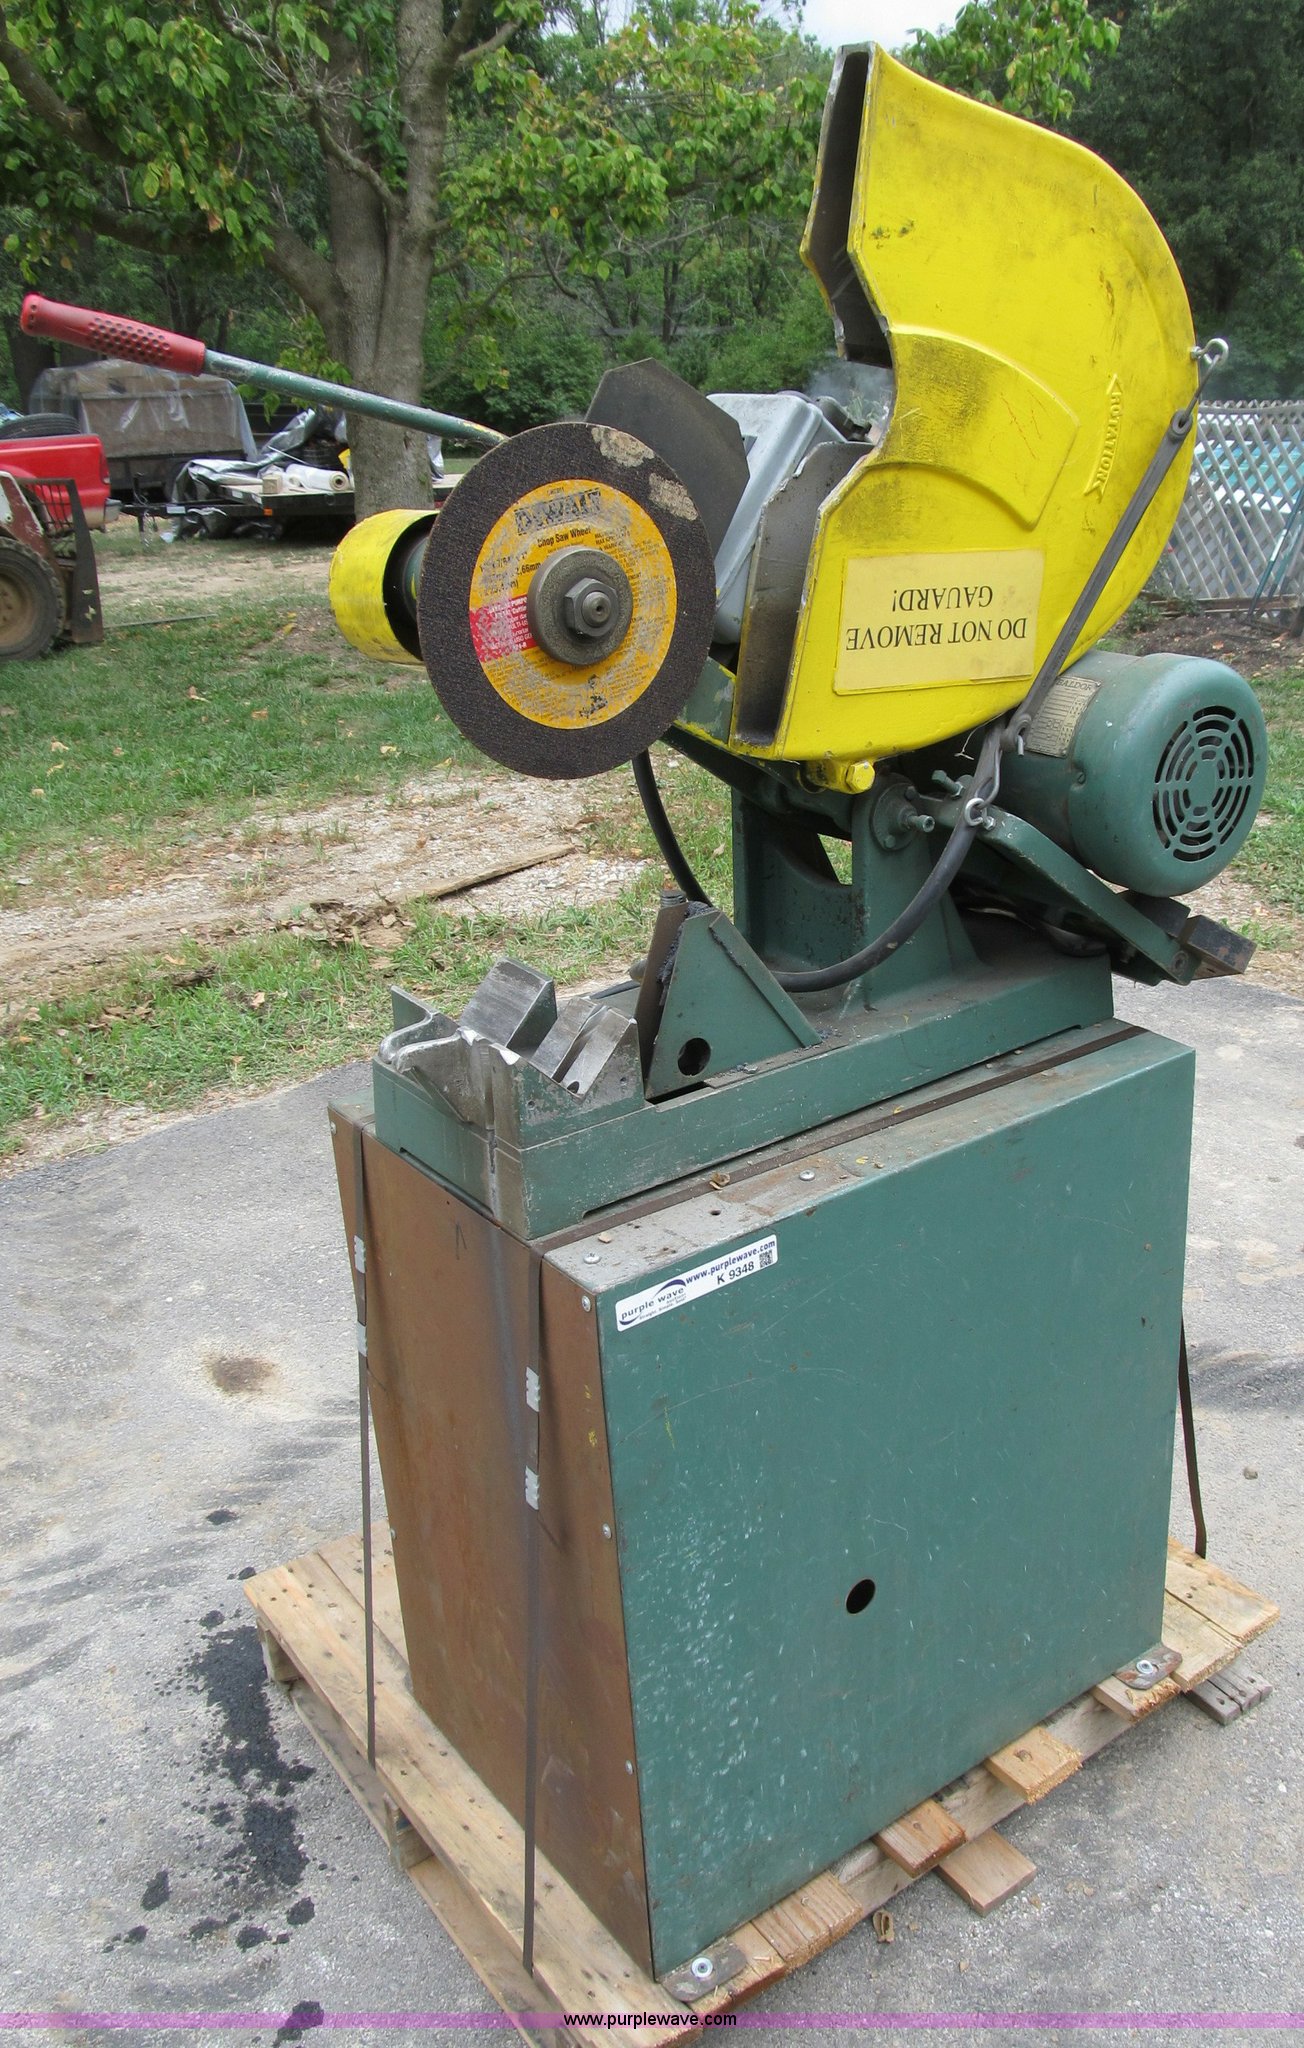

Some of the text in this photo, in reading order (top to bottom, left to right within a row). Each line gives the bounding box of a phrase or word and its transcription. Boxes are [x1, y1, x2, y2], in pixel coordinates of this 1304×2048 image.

[1096, 391, 1122, 483] ROTATION
[555, 532, 569, 542] Saw
[891, 585, 993, 612] GAUARD!
[846, 617, 1028, 651] DO NOT REMOVE
[1056, 679, 1092, 691] BALDOR
[686, 1240, 776, 1285] www.purplewave.com
[717, 1261, 755, 1285] K 9348
[621, 1287, 685, 1320] purple wave
